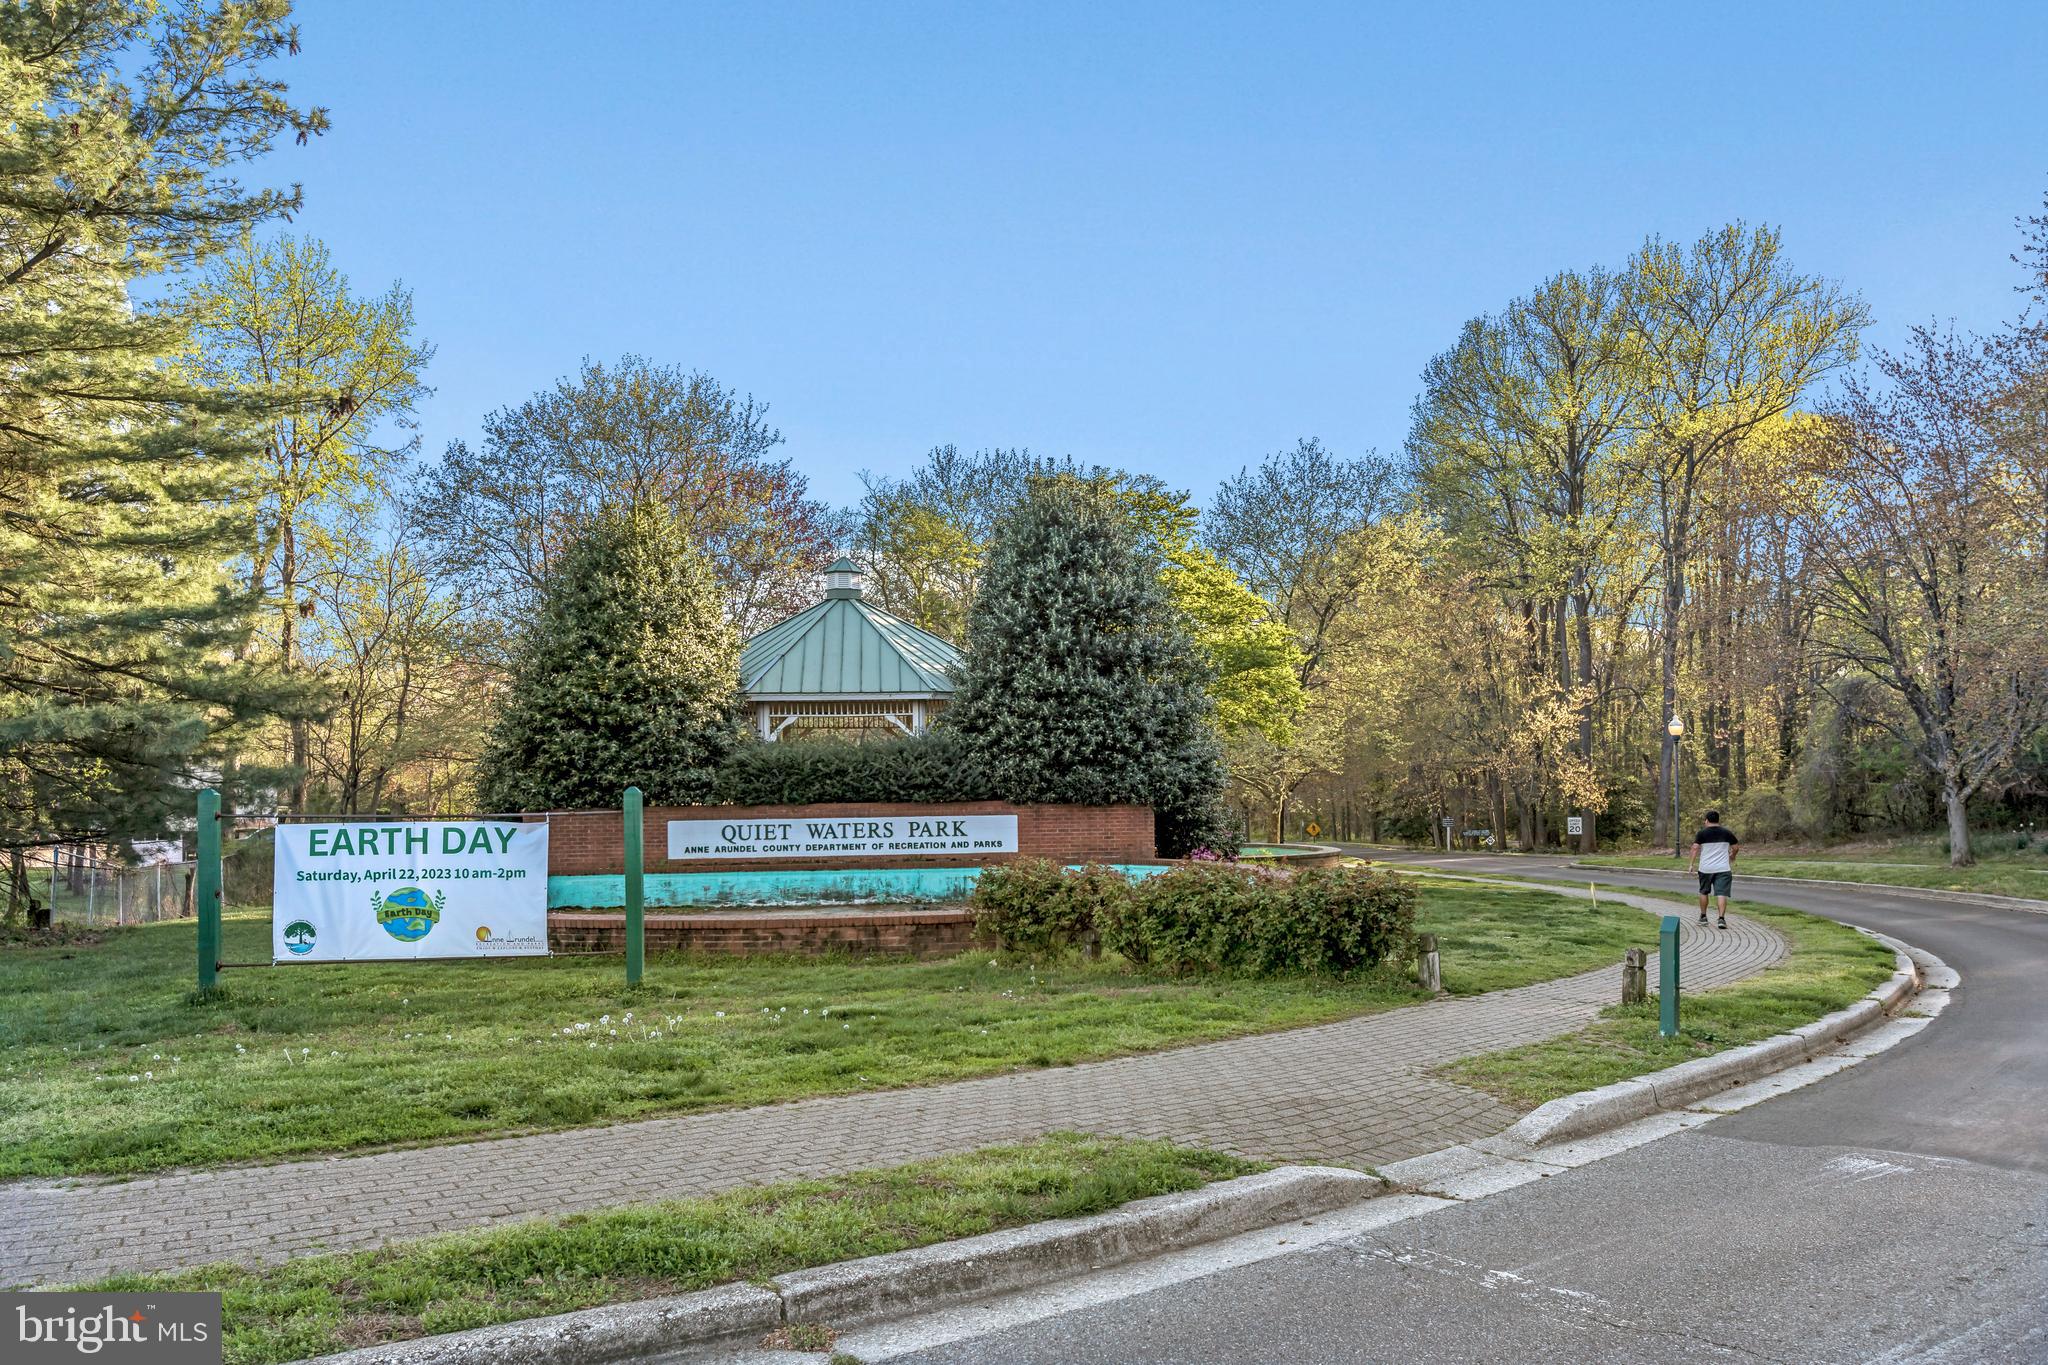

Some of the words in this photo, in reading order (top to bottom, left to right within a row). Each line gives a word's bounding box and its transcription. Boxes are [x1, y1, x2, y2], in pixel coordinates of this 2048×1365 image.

[721, 824, 792, 844] QUIET
[806, 822, 894, 839] WATERS
[908, 820, 968, 838] PARK
[309, 827, 429, 857] EARTH
[442, 827, 518, 854] DAY
[684, 846, 709, 854] ANNE
[714, 845, 758, 853] ARUNDEL
[762, 844, 801, 852] COUNTY
[805, 843, 867, 851] DEPARTMENT
[888, 841, 946, 850] RECREATION
[951, 841, 970, 849] AND
[973, 840, 1003, 848] PARKS
[296, 869, 361, 883] Saturday,
[364, 868, 396, 882] April
[399, 868, 419, 881] 22,
[421, 868, 452, 879] 2023
[454, 868, 470, 879] 10
[472, 867, 526, 881] am-2pm
[384, 908, 412, 918] Earth
[415, 908, 433, 919] Day
